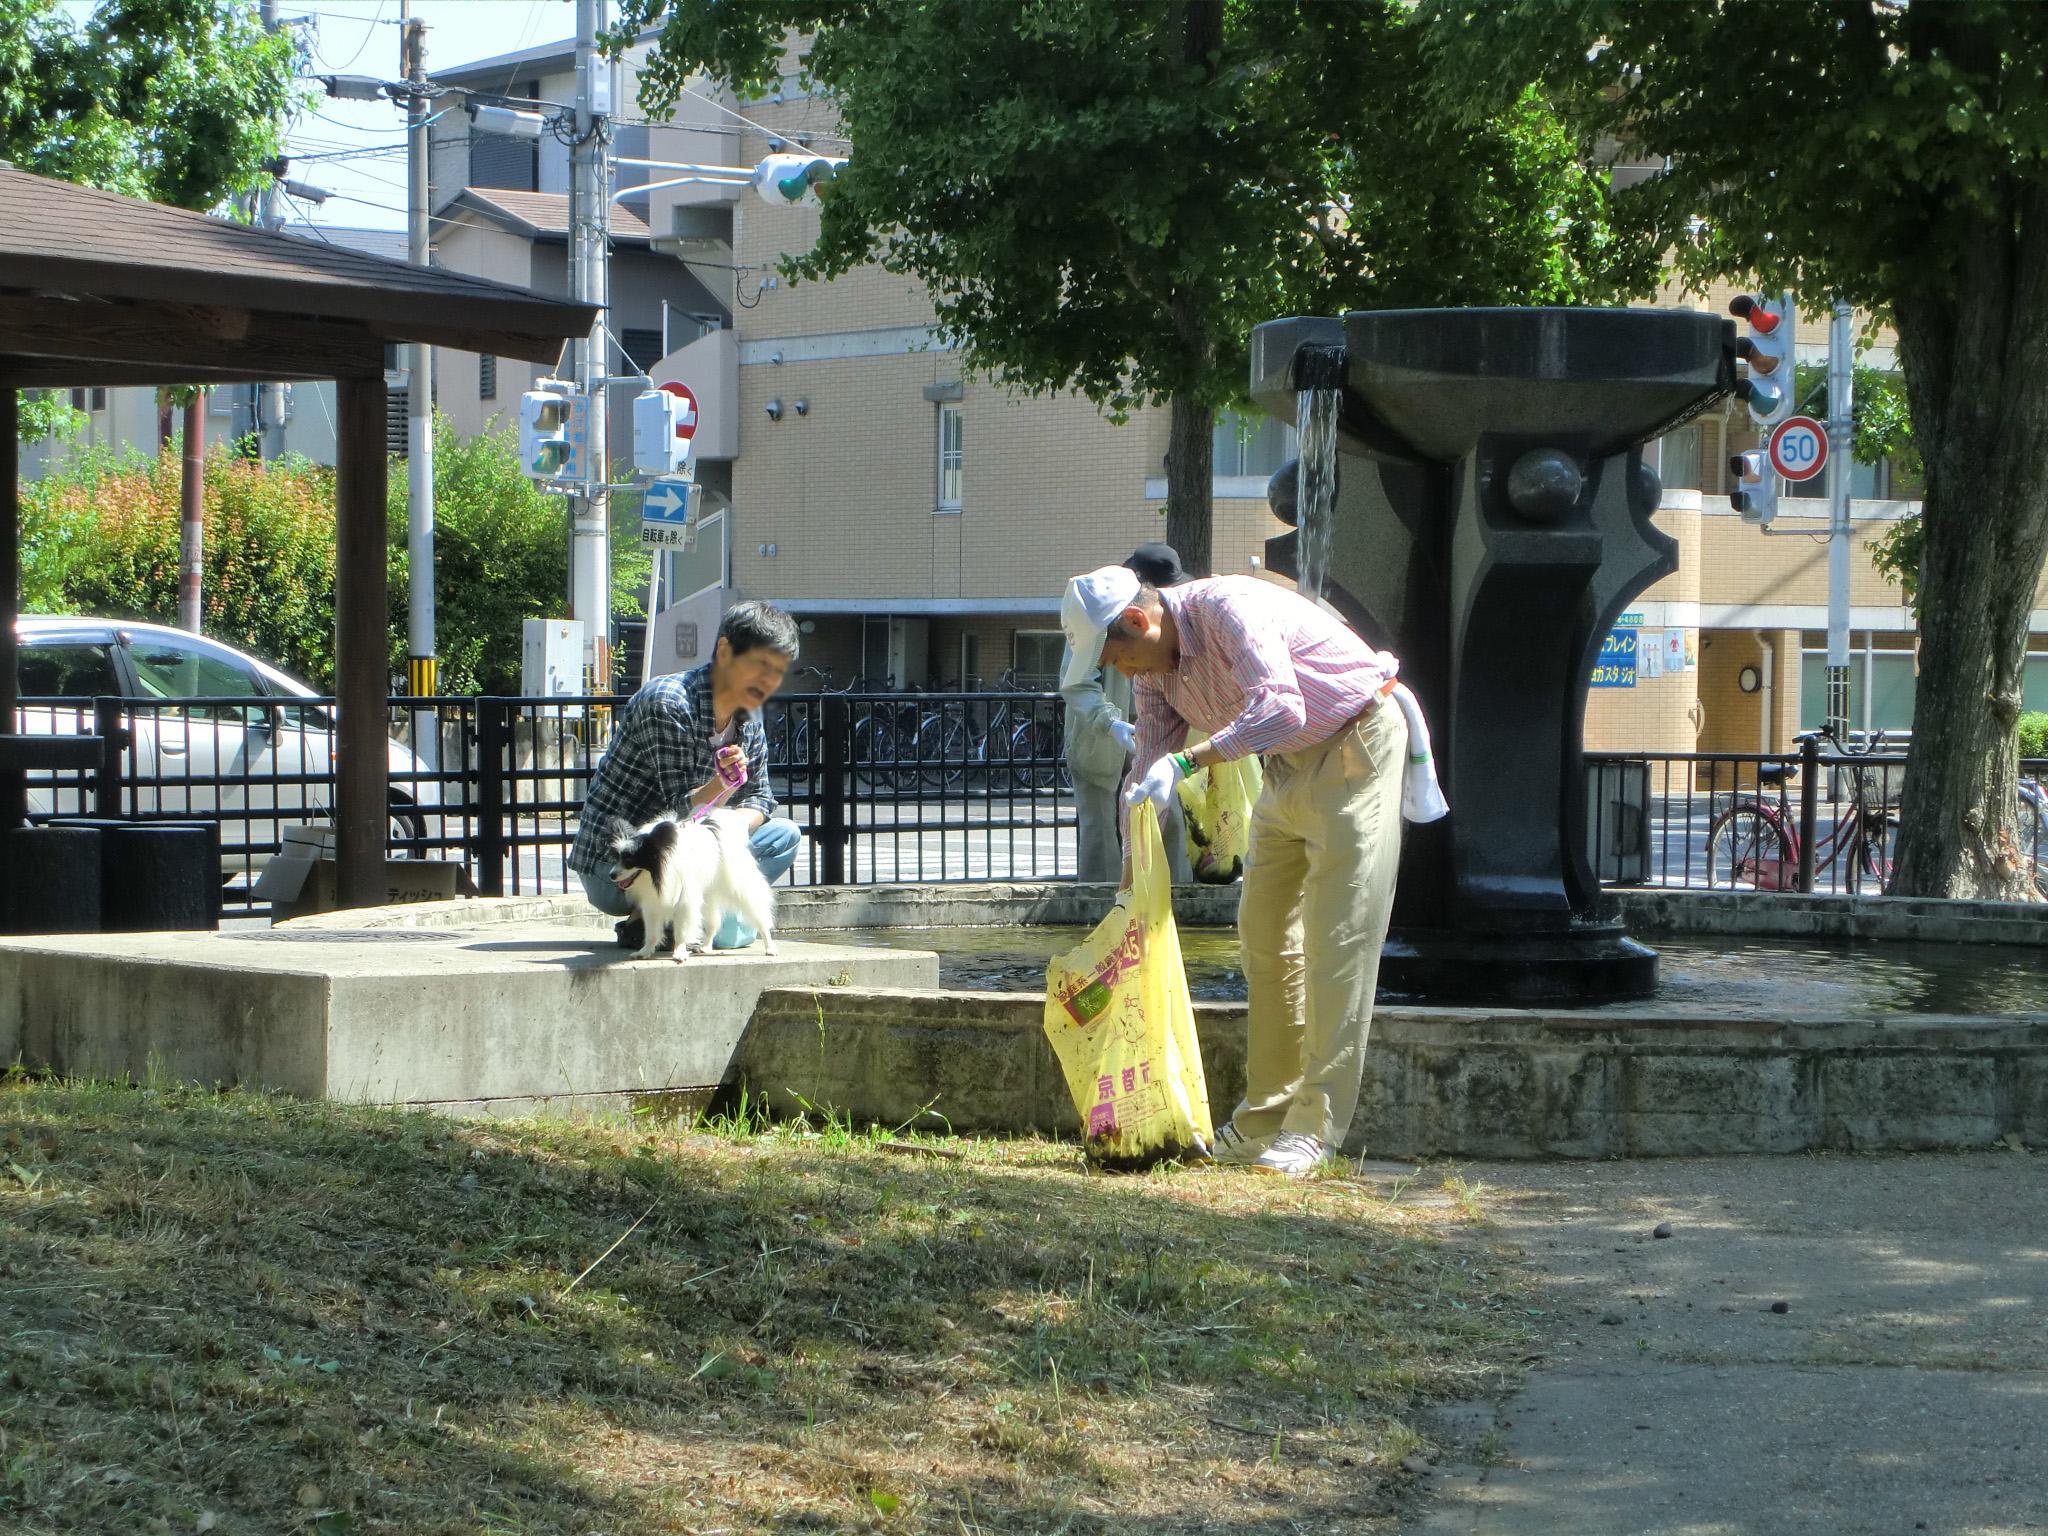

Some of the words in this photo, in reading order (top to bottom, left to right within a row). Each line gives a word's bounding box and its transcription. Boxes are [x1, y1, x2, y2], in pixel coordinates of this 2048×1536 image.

[1782, 435, 1815, 463] 50
[642, 527, 683, 545] 自転車を除く
